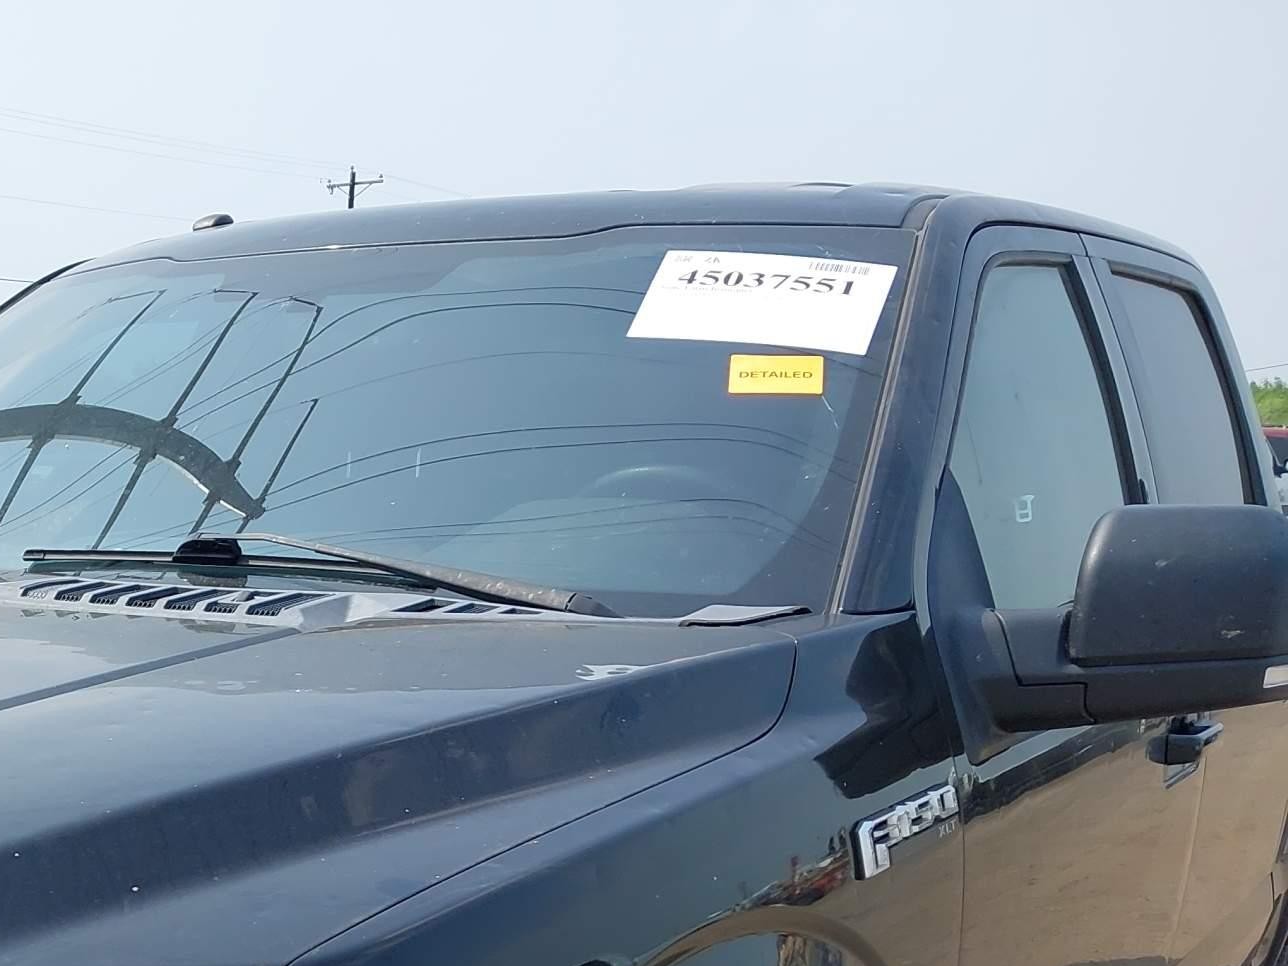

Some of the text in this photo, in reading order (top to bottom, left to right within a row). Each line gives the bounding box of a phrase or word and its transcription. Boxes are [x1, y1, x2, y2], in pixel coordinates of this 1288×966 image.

[677, 268, 854, 296] 45037551
[738, 370, 813, 379] DETAILED
[938, 819, 957, 838] XLT
